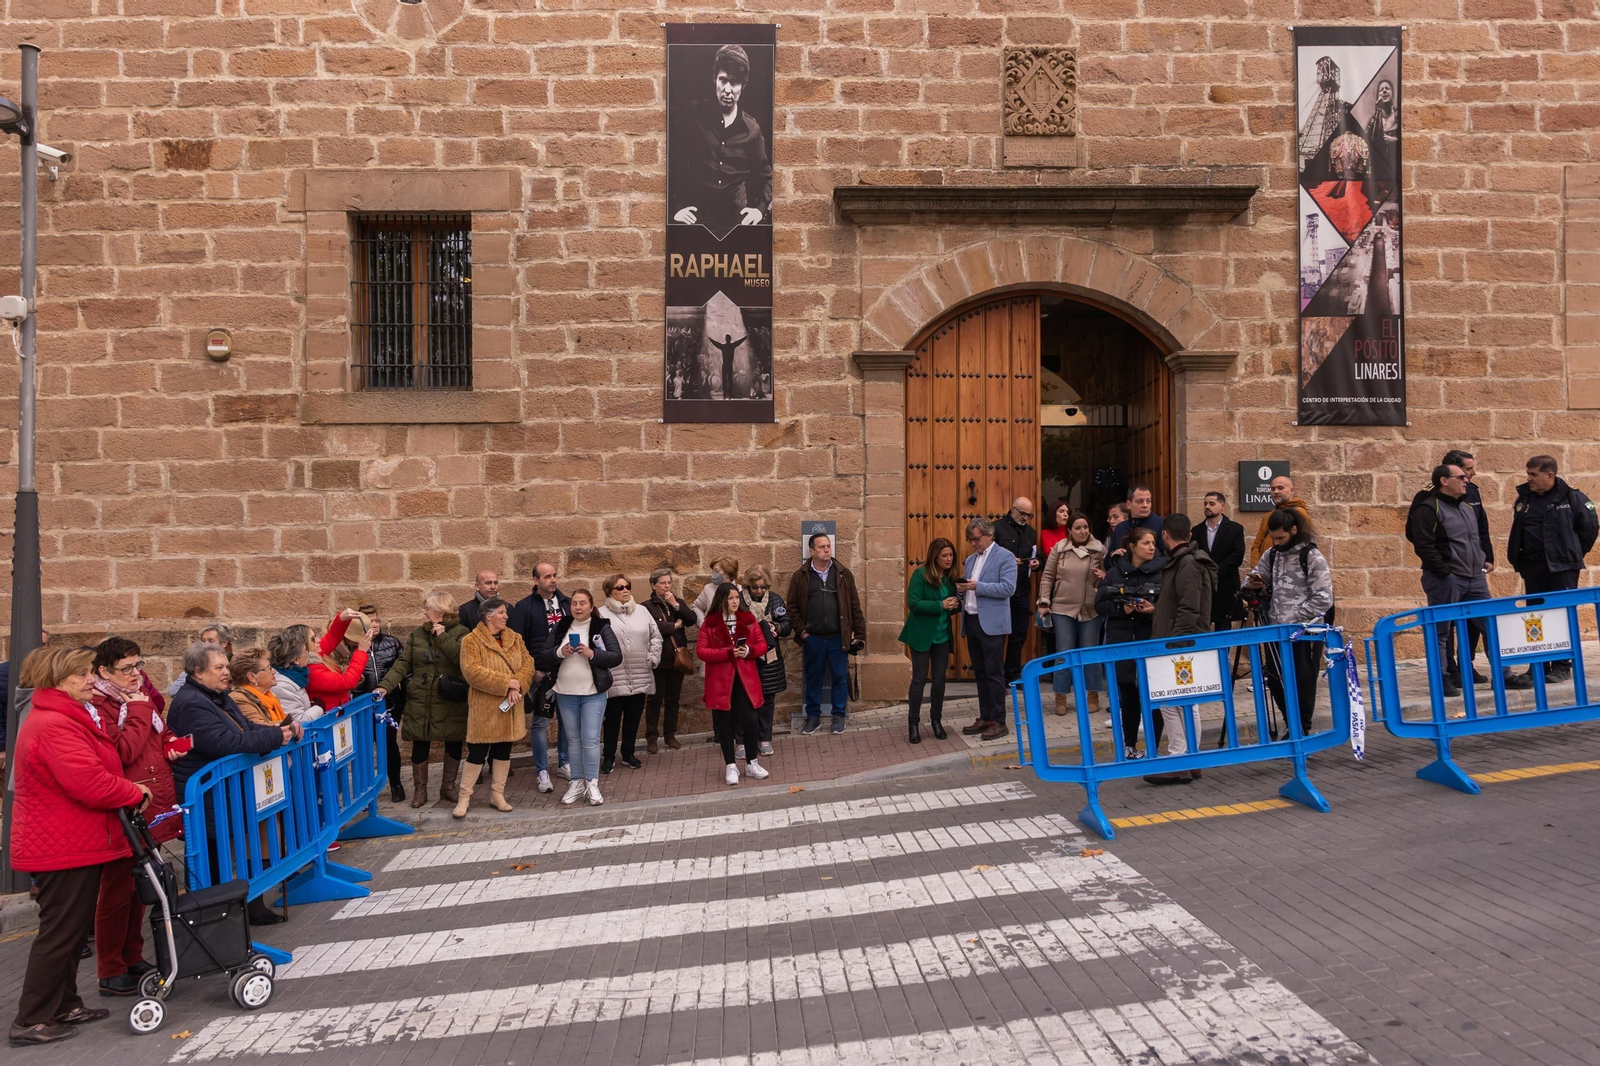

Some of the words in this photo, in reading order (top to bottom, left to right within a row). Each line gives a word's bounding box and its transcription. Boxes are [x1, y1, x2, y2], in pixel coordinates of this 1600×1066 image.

[670, 253, 770, 278] RAPHAEL
[744, 278, 770, 287] MUSEO
[1382, 318, 1395, 338] EL
[1354, 337, 1398, 359] PÓSITO
[1354, 362, 1398, 380] LINARES
[1246, 494, 1275, 505] LINAR
[1517, 644, 1547, 653] AYUNTAMIENTO
[1166, 687, 1197, 696] AYUNTAMIENTO
[1203, 684, 1221, 692] LINARES
